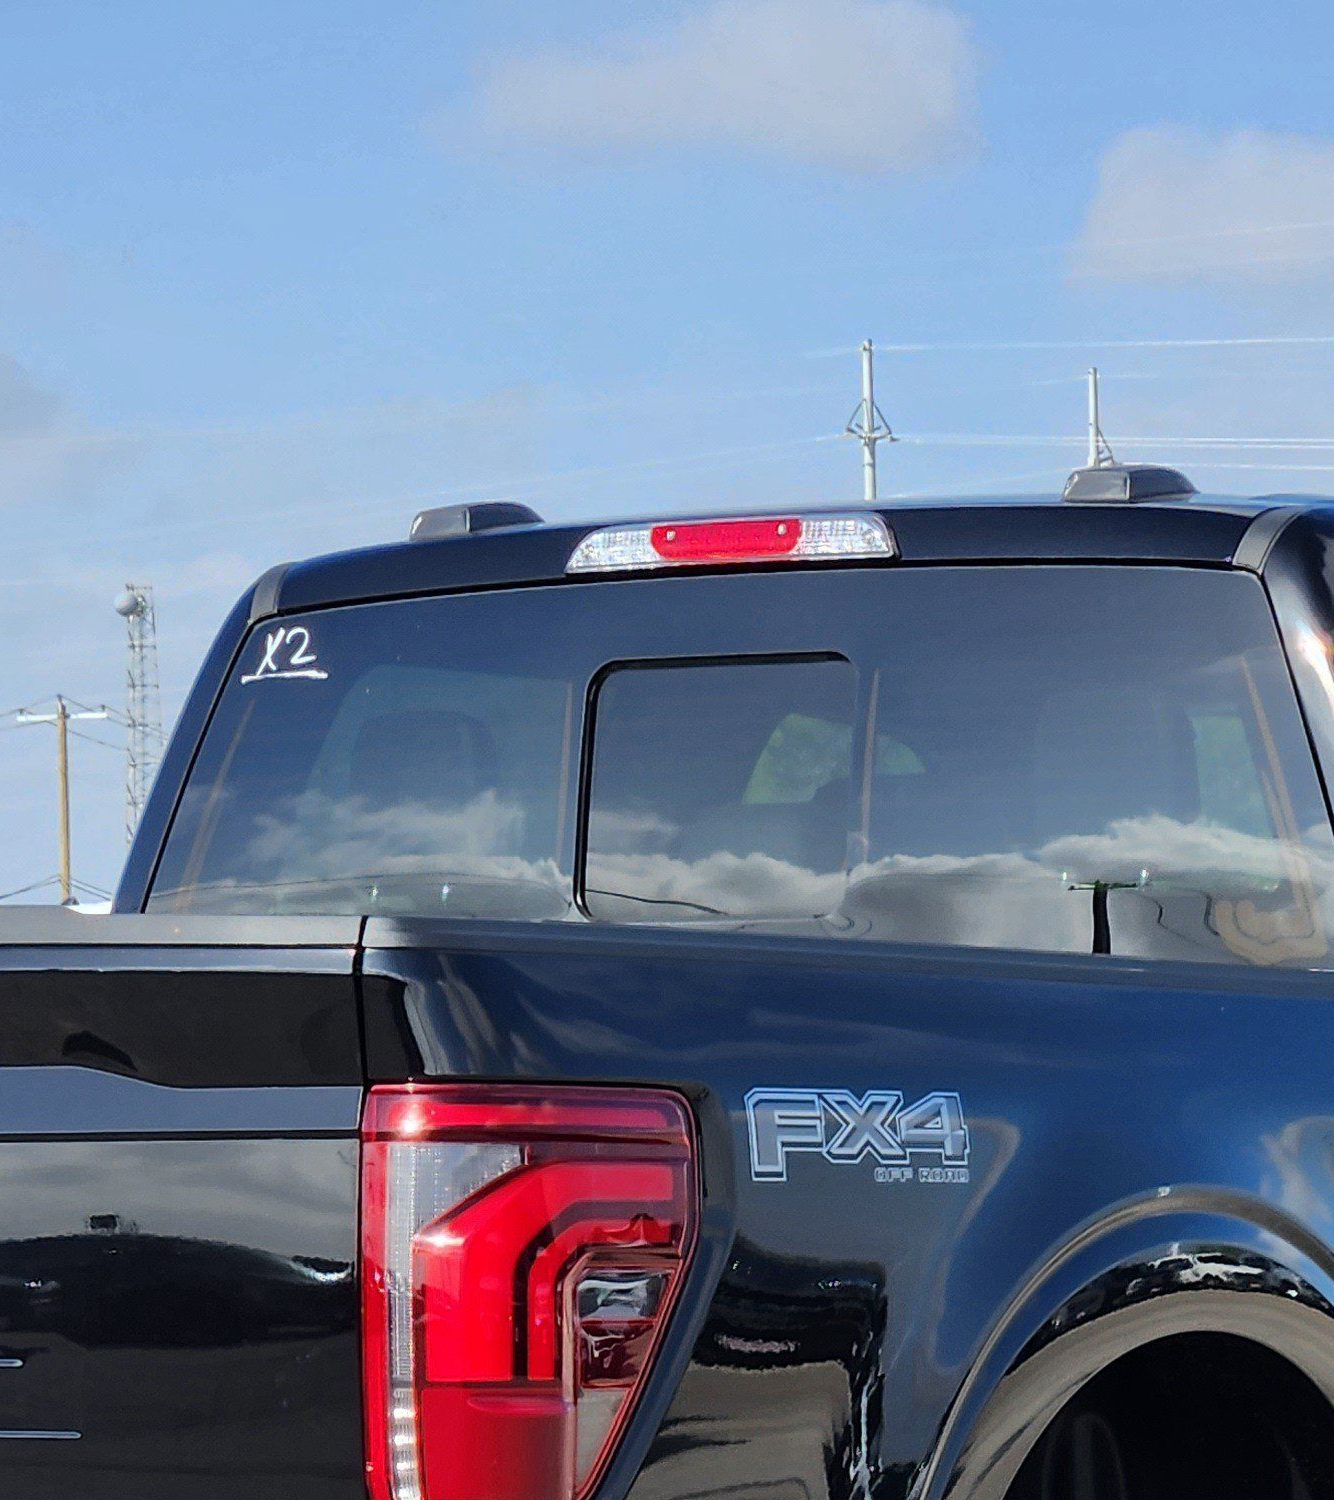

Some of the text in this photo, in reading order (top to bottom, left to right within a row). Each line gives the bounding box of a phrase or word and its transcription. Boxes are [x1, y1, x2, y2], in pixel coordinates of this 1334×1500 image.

[255, 626, 318, 676] X2
[744, 1087, 970, 1182] FX4
[874, 1166, 970, 1183] OFF ROAD
